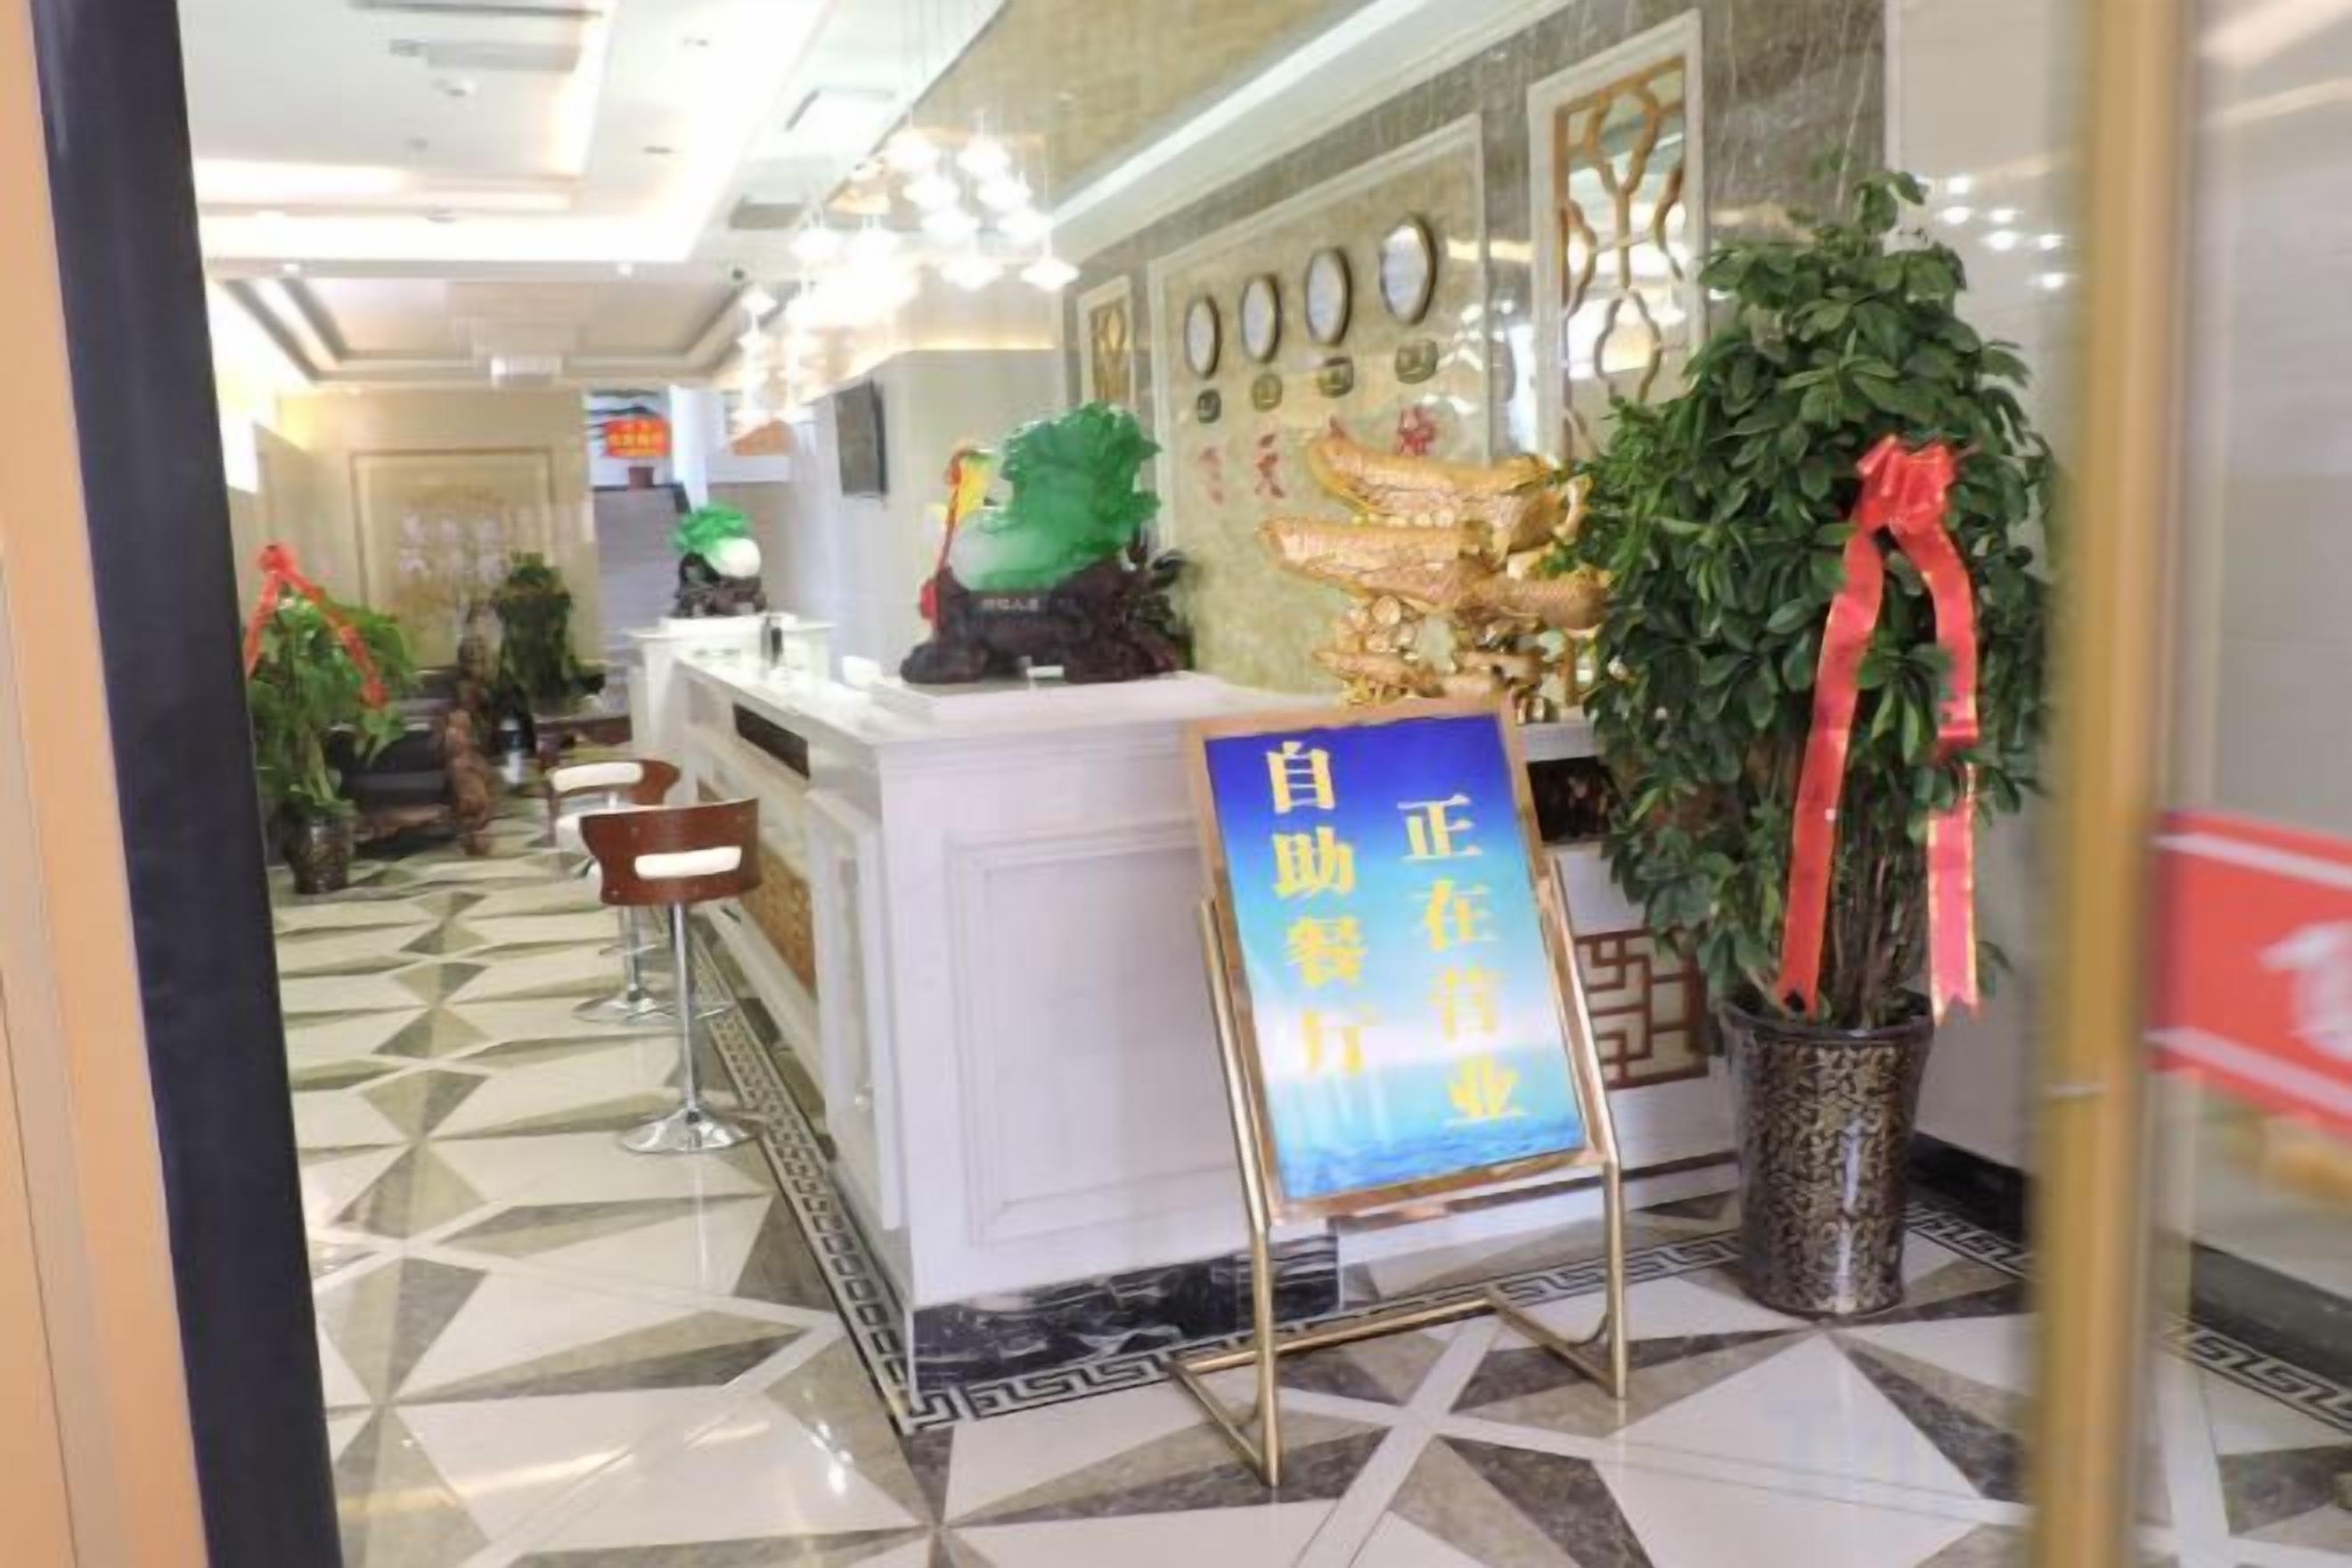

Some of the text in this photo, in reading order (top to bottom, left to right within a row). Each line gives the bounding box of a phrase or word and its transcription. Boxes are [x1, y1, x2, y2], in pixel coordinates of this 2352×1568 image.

[1266, 740, 1376, 1074] 自助餐厅
[1397, 794, 1528, 1126] 正在营业
